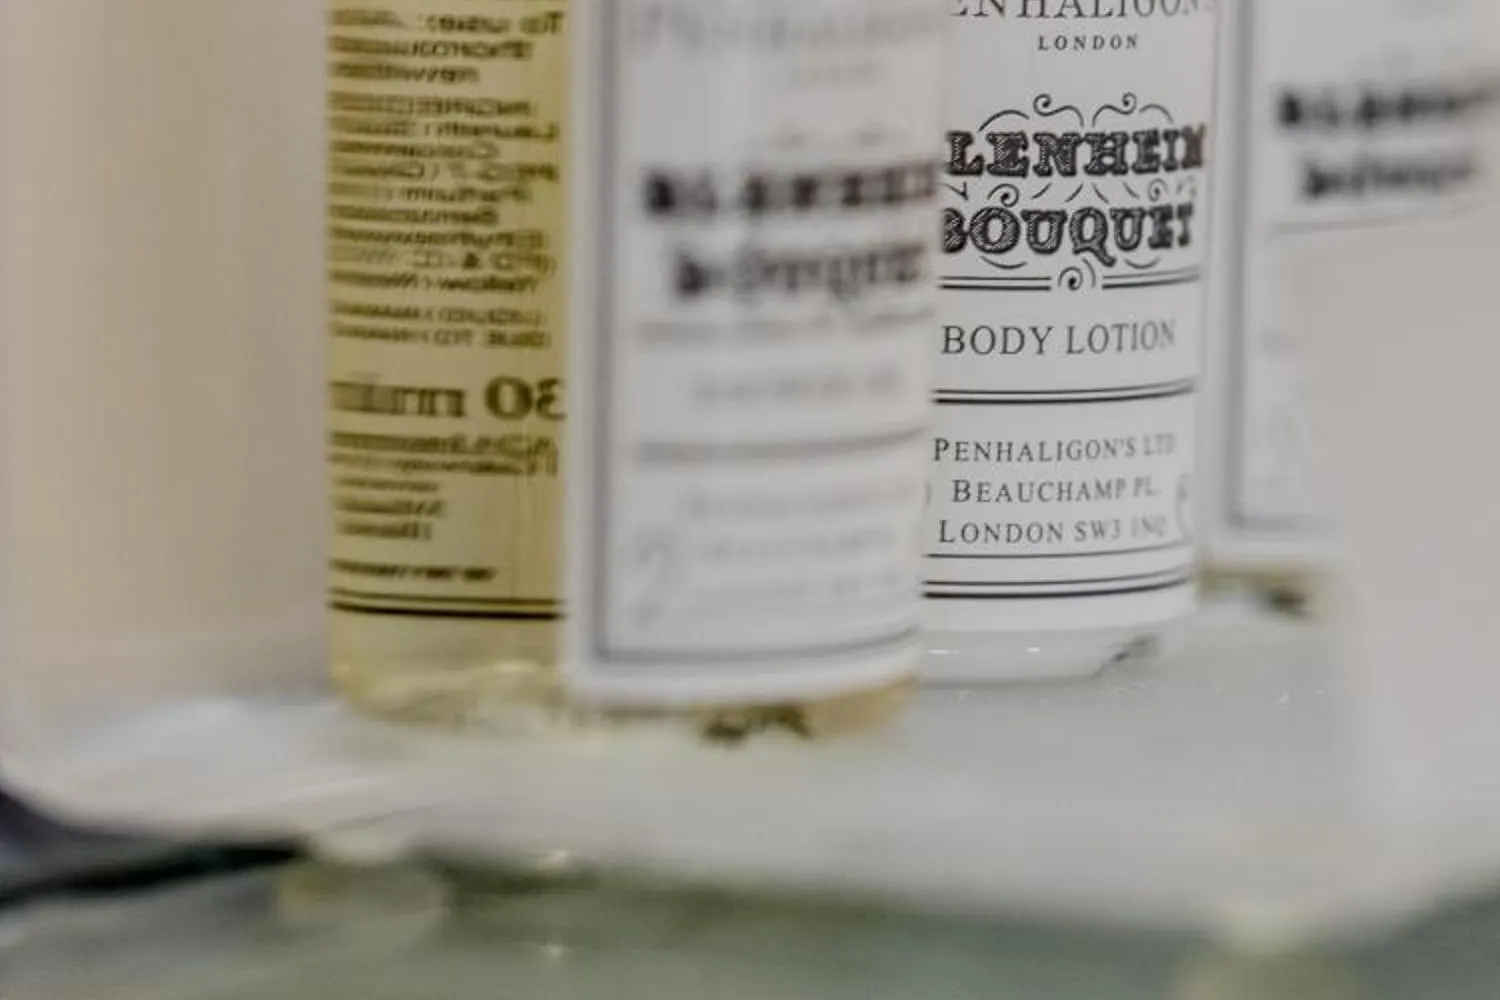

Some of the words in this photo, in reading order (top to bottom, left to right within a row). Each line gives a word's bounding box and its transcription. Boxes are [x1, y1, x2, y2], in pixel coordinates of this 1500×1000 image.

[1038, 33, 1138, 51] LONDON
[942, 201, 1194, 267] BOUQUET
[941, 325, 1053, 355] BODY
[1066, 319, 1177, 355] LOTION
[933, 436, 1137, 462] PENHALIGON'S
[952, 477, 1127, 503] BEAUCHAMP
[938, 519, 1063, 544] LONDON
